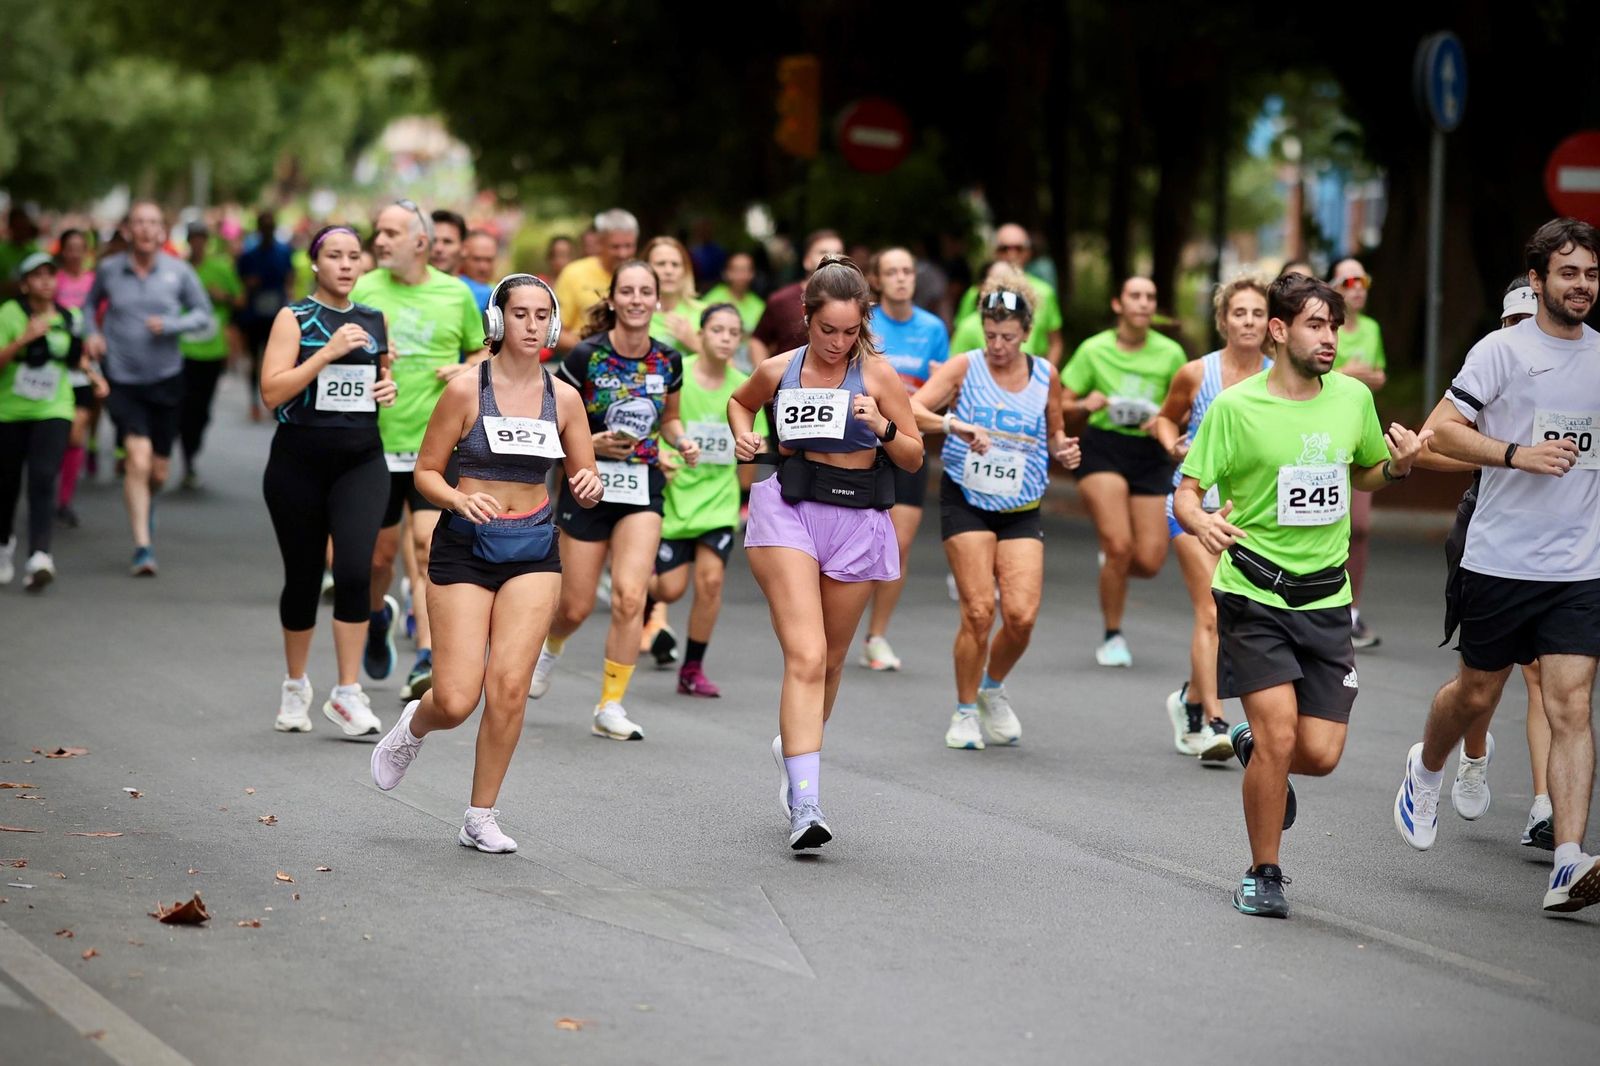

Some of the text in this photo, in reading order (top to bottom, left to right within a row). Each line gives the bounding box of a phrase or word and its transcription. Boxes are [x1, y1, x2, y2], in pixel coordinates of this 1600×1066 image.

[327, 382, 364, 396] 205
[784, 405, 834, 424] 326
[497, 430, 546, 445] 927
[971, 461, 1016, 480] 1154
[600, 473, 638, 490] 825
[831, 488, 855, 496] KIPRUN
[1289, 486, 1339, 507] 245
